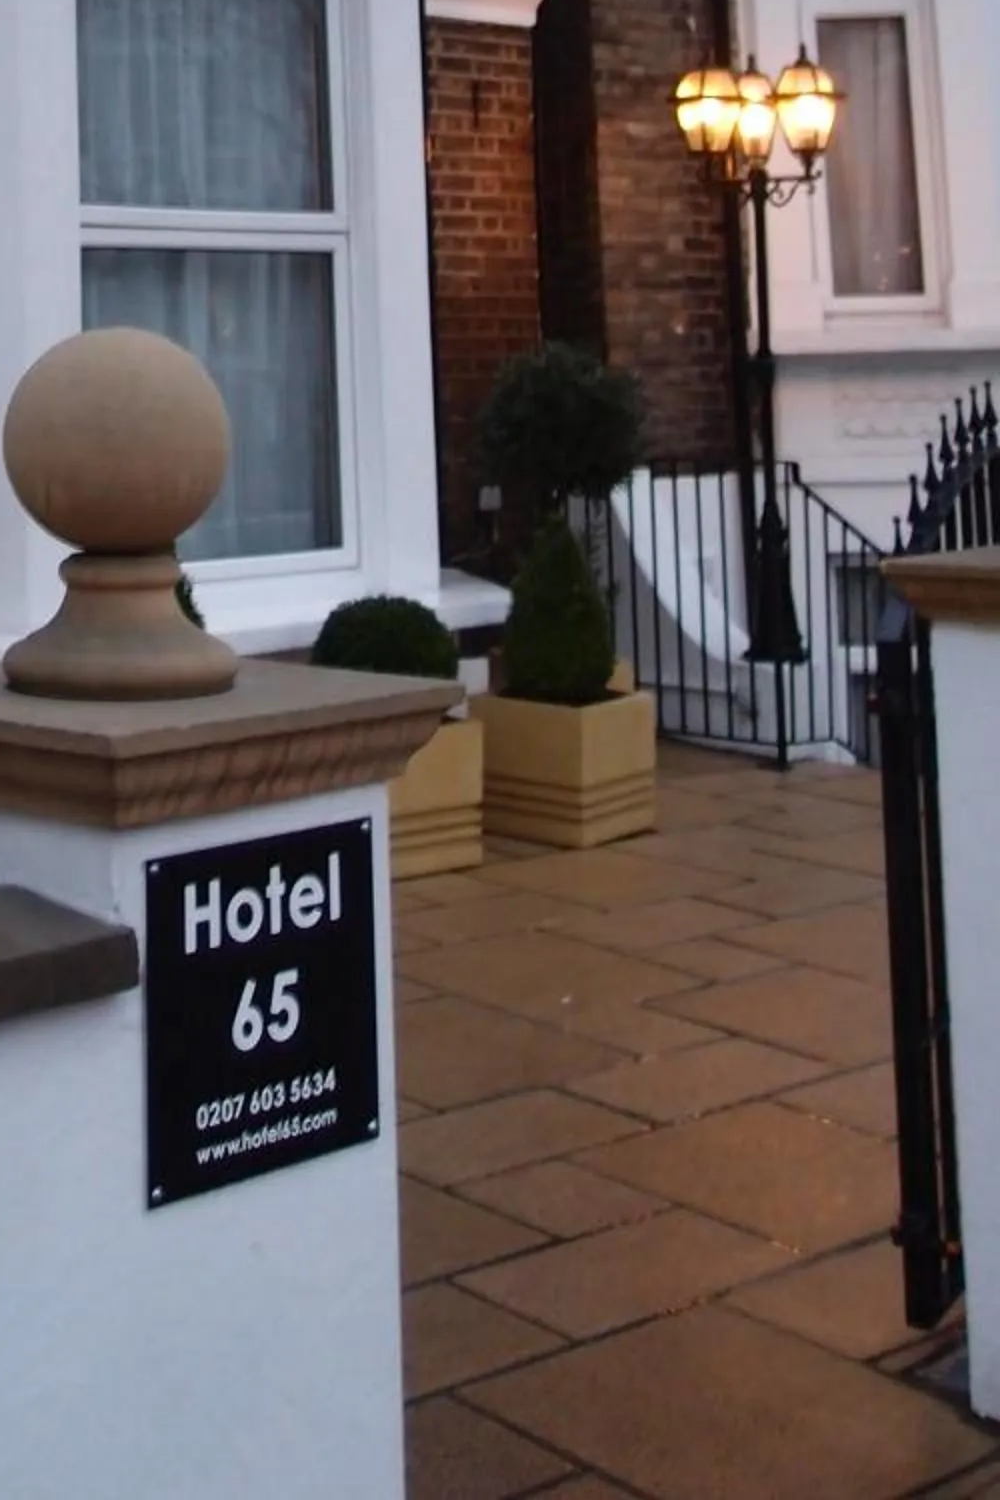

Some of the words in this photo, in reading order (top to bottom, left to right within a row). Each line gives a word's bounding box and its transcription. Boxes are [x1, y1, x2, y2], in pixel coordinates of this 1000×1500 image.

[183, 851, 341, 955] Hotel
[231, 968, 300, 1052] 65
[195, 1094, 245, 1131] 0207
[249, 1084, 285, 1115] 603
[289, 1067, 337, 1102] 5634
[195, 1107, 338, 1165] www.hotel65.com
